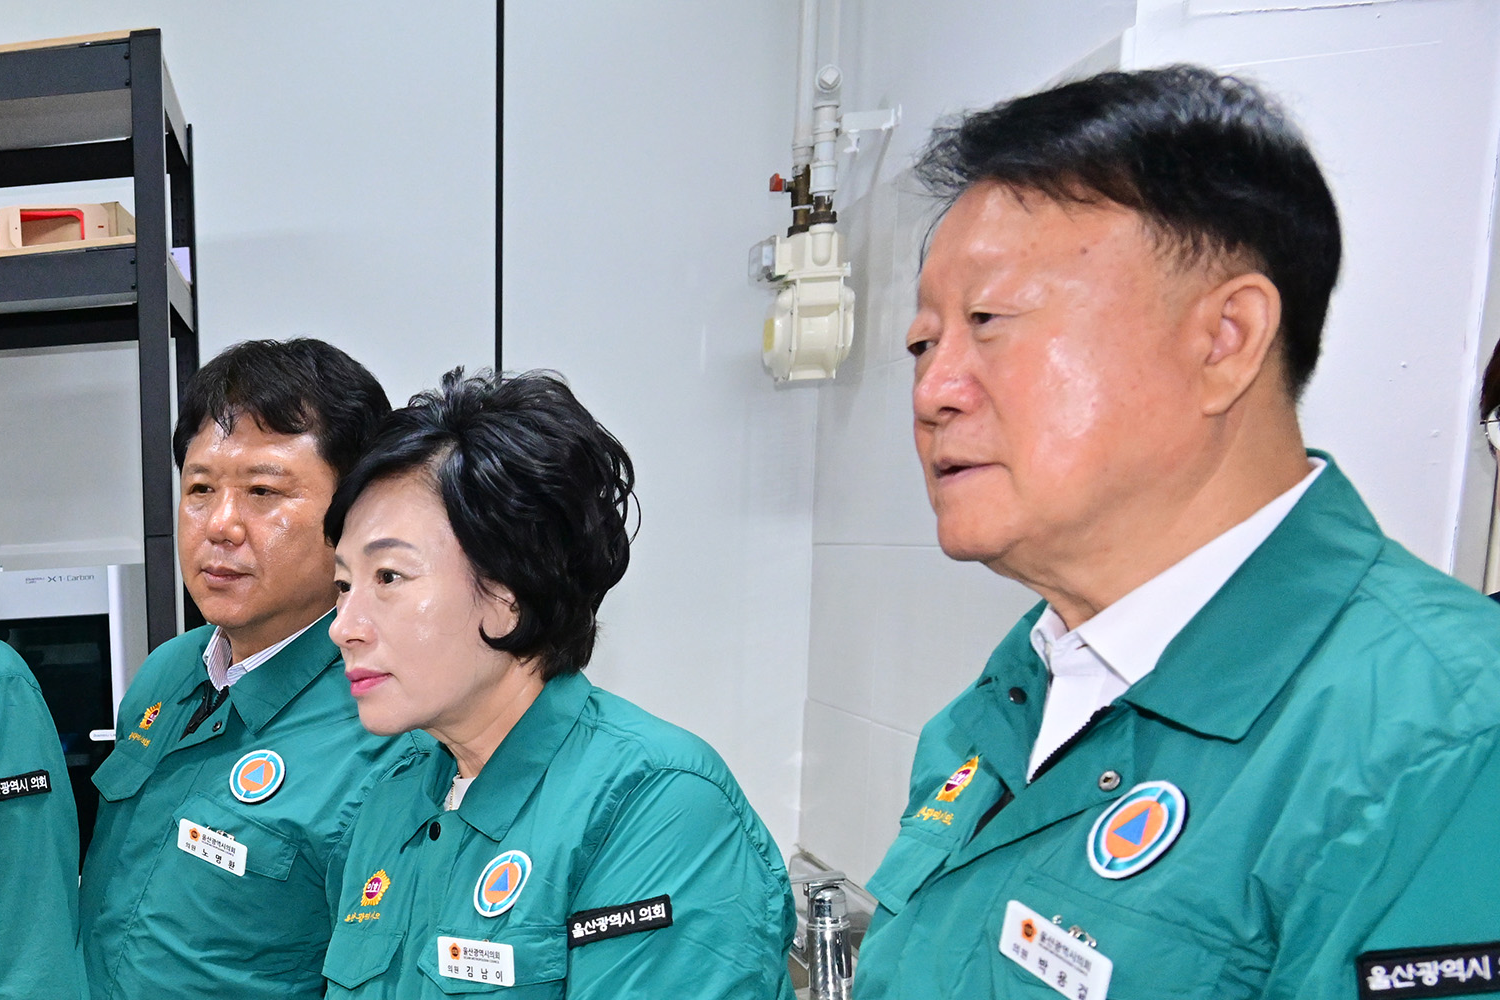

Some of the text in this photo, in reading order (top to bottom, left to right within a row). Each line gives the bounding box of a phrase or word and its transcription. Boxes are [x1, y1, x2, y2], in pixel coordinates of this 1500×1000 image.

[30, 775, 48, 789] 의회
[201, 833, 236, 855] 울산광역시의회
[572, 902, 666, 939] 울산광역시 의회
[462, 946, 501, 960] 울산광역시의회
[447, 964, 503, 982] 의원 김남이
[1366, 955, 1492, 991] 울산광역시
